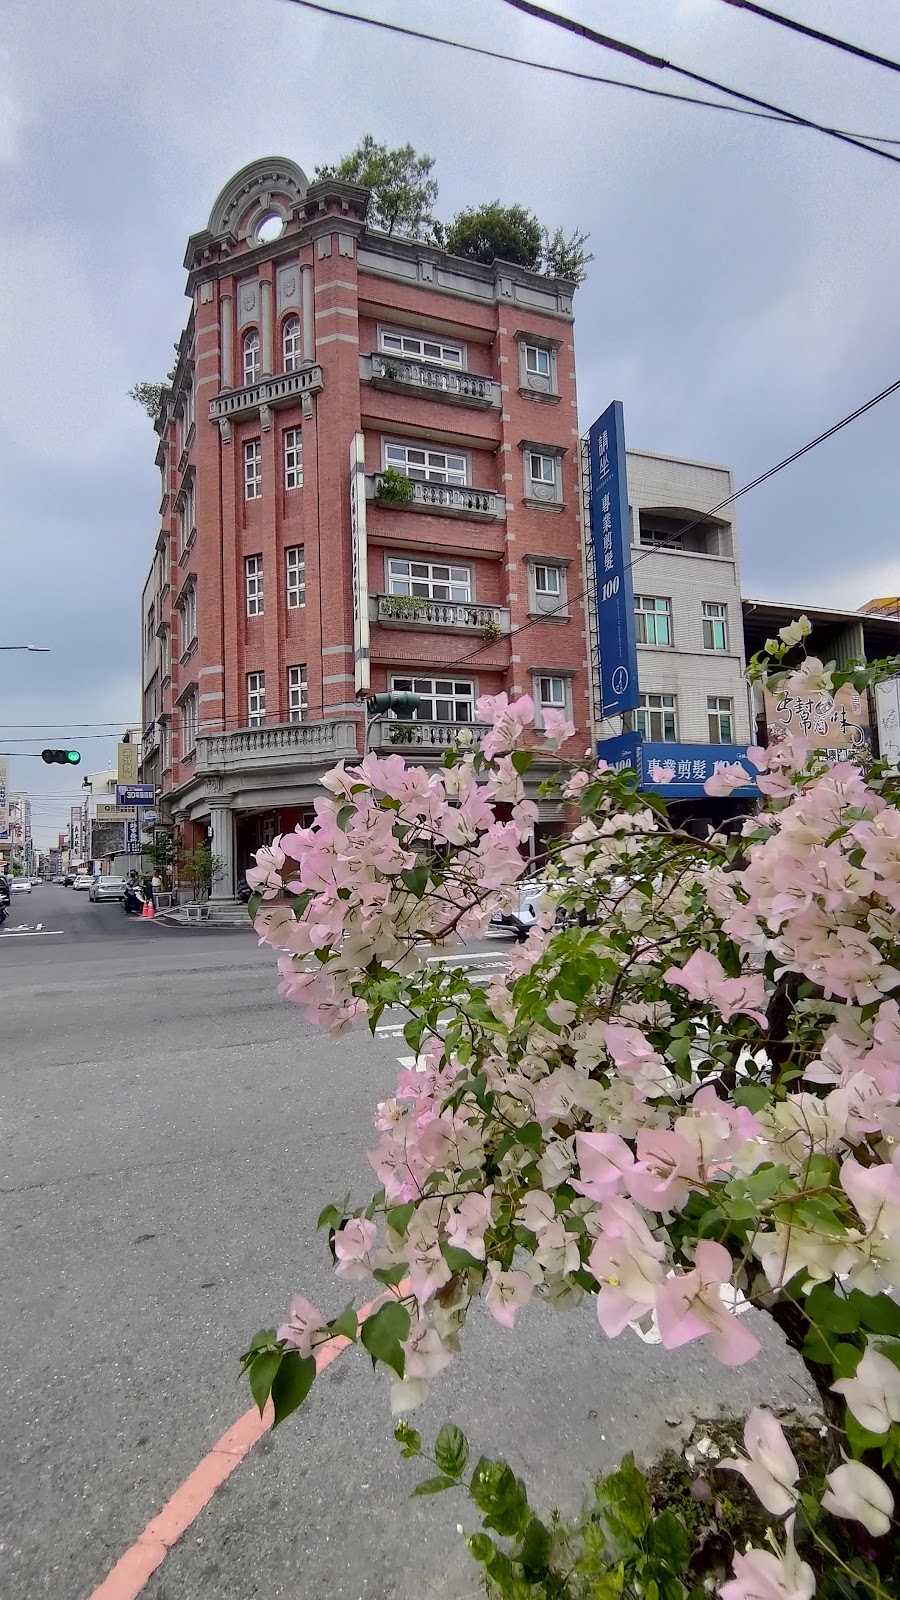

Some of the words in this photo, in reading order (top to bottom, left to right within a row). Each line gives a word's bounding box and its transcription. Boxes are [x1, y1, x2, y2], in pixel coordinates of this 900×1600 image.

[597, 429, 609, 479] 請坐
[601, 493, 613, 571] 專業剪髮
[601, 576, 619, 602] 100
